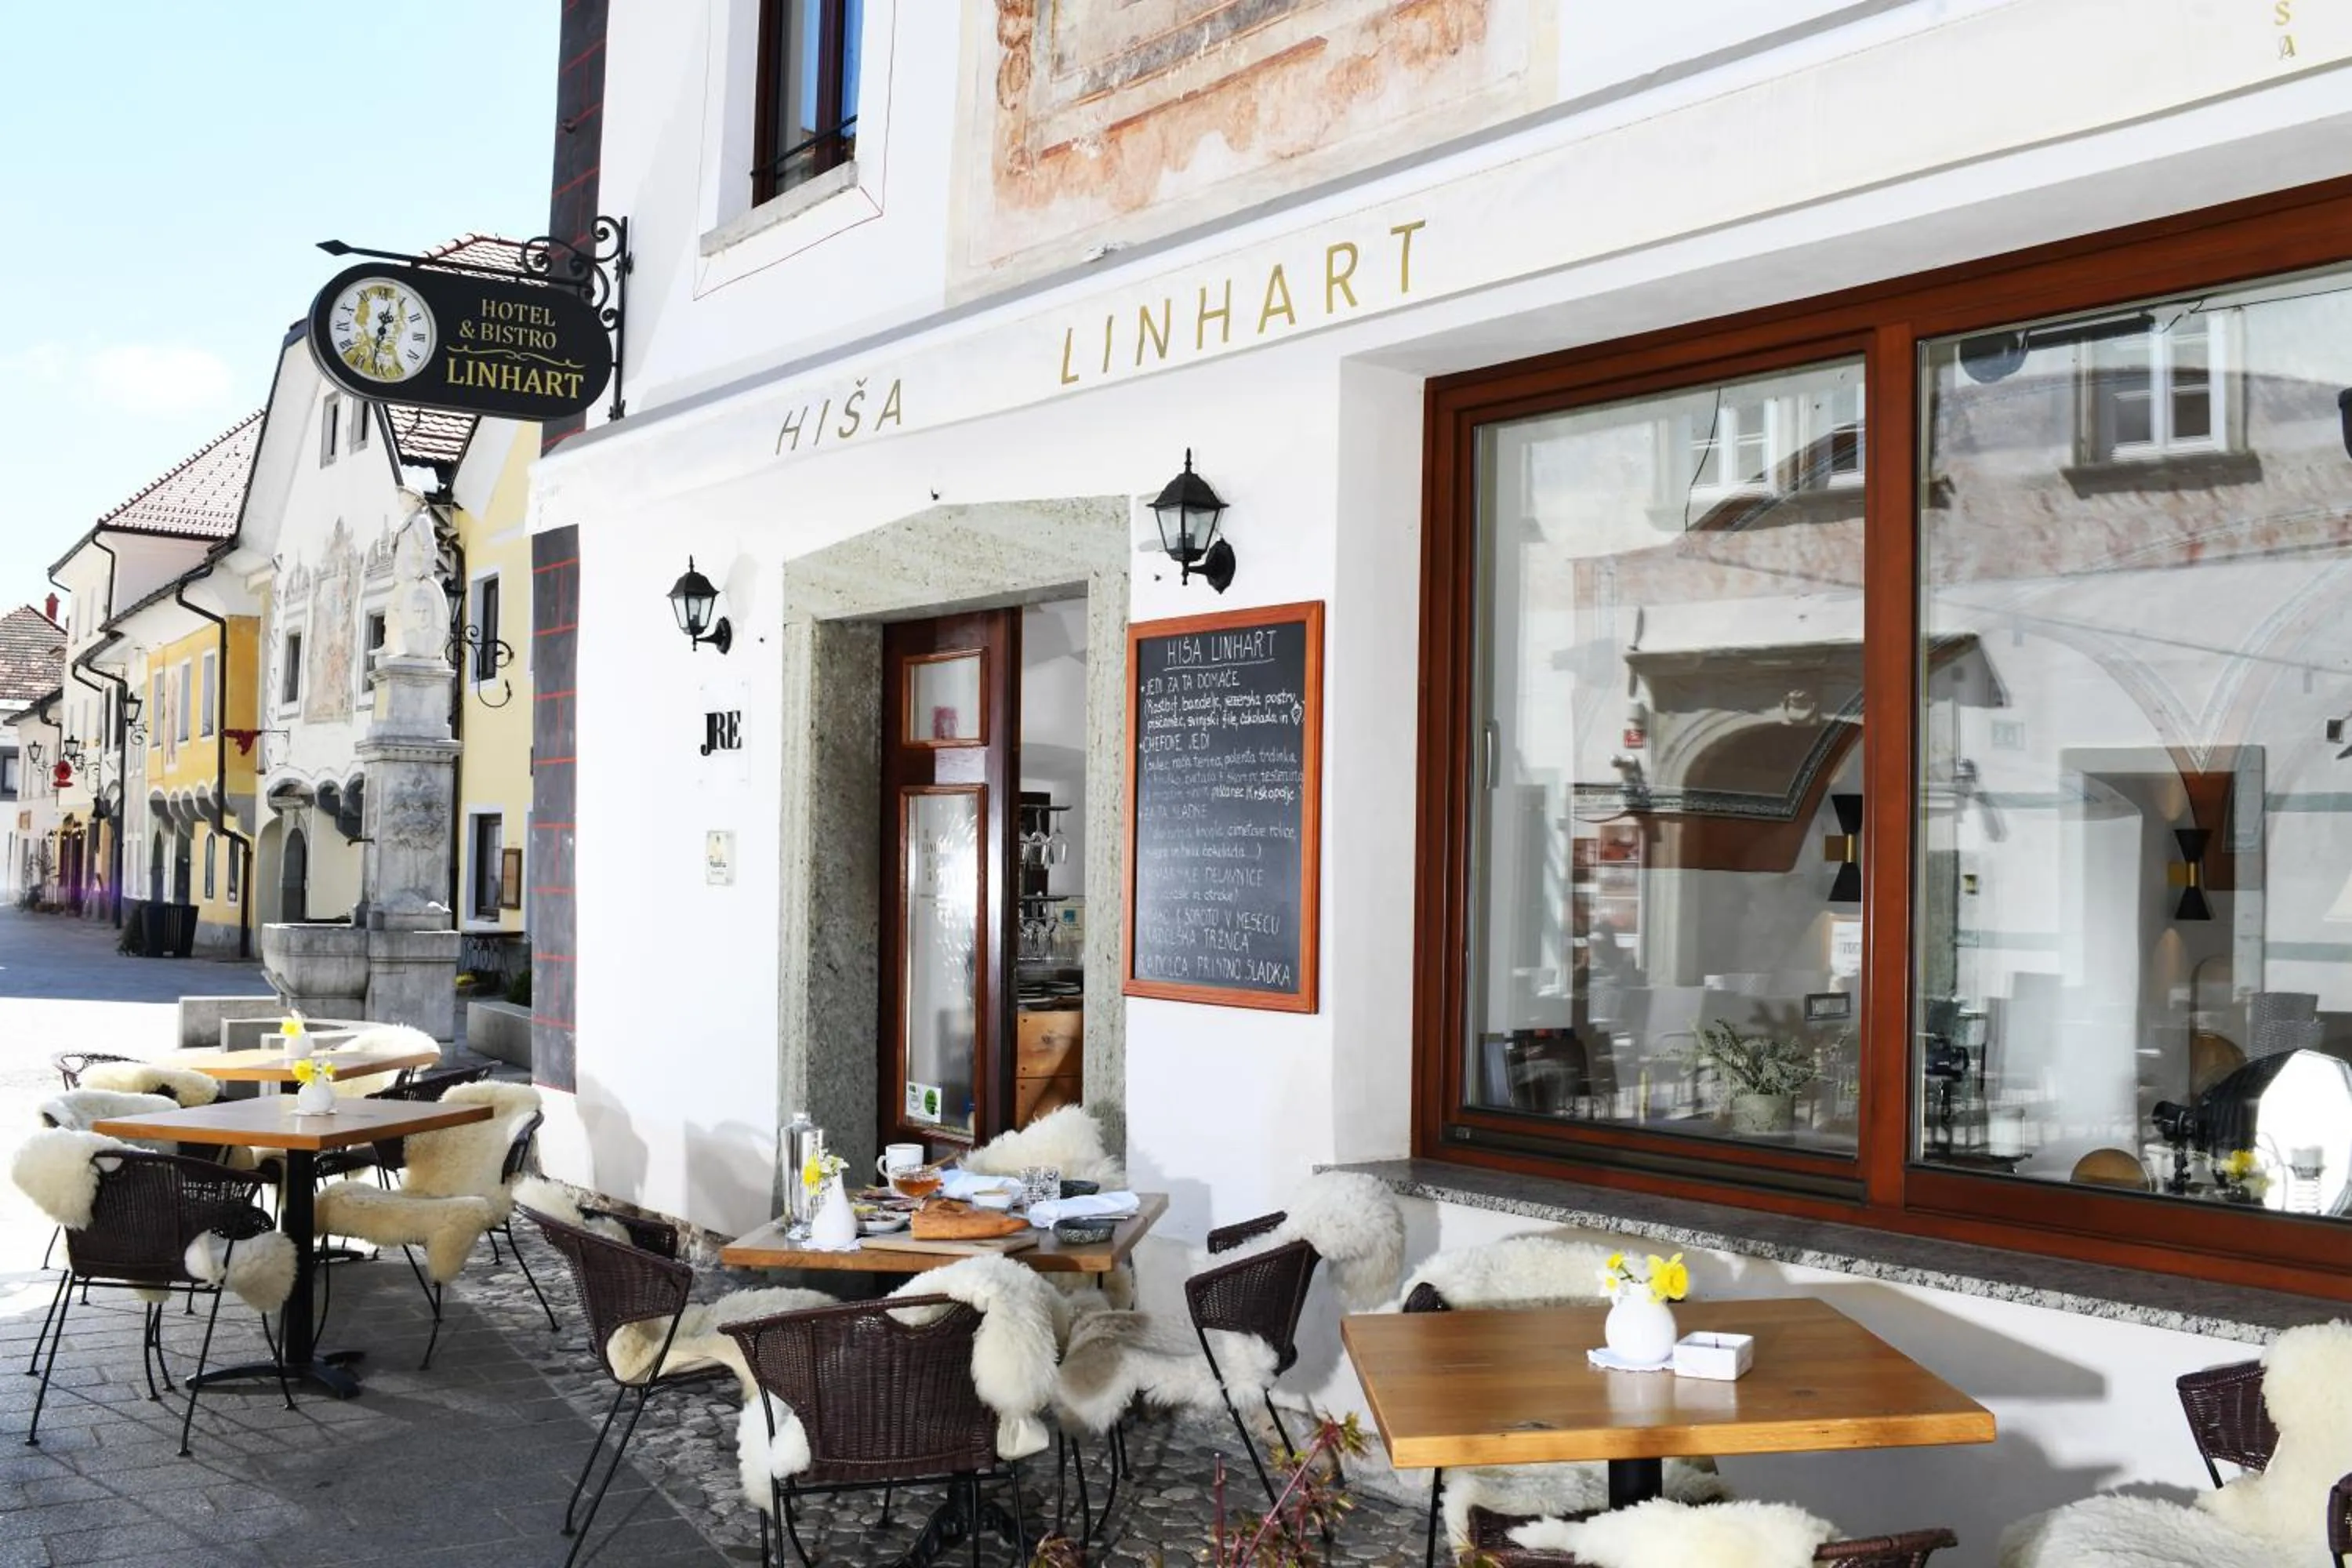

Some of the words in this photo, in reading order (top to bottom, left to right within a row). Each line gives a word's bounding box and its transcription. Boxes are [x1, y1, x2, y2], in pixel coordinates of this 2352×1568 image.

[481, 299, 557, 328] HOTEL
[459, 319, 476, 339] &
[480, 322, 557, 350] BISTRO
[775, 376, 903, 456] HIŠA
[1061, 220, 1426, 386] LINHART
[445, 357, 585, 399] LINHART
[1167, 637, 1203, 666] HIŠA
[1211, 630, 1277, 661] LINHART
[1167, 677, 1179, 693] ZA
[1182, 674, 1192, 691] TA
[1236, 910, 1280, 936] MESECU
[1243, 958, 1292, 988] SLADKA
